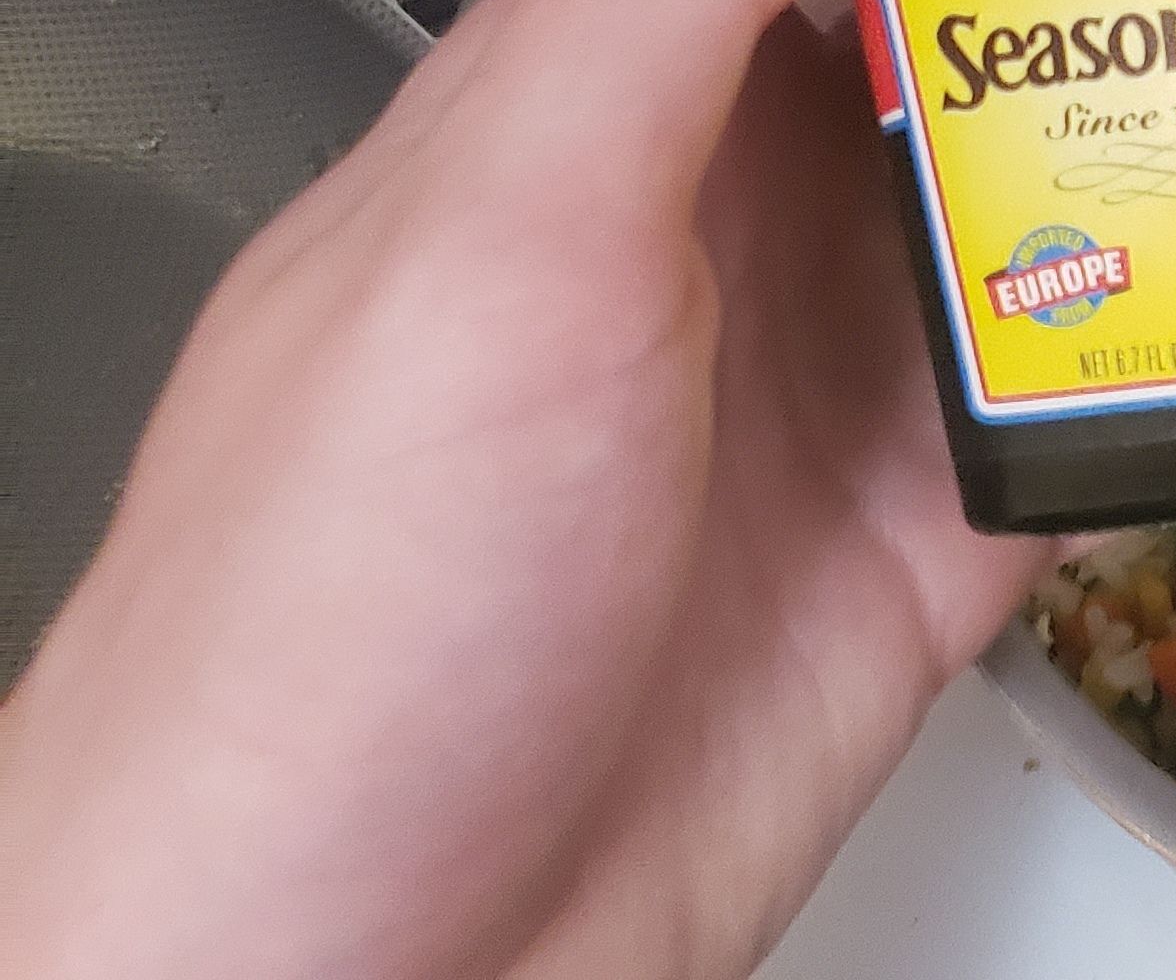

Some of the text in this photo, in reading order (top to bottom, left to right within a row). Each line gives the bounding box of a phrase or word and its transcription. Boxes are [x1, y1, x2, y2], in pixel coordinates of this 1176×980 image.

[1045, 103, 1159, 140] Since
[995, 251, 1125, 316] EUROPE
[1080, 350, 1110, 379] NET
[1115, 346, 1139, 375] 6.7
[1145, 342, 1166, 372] FL
